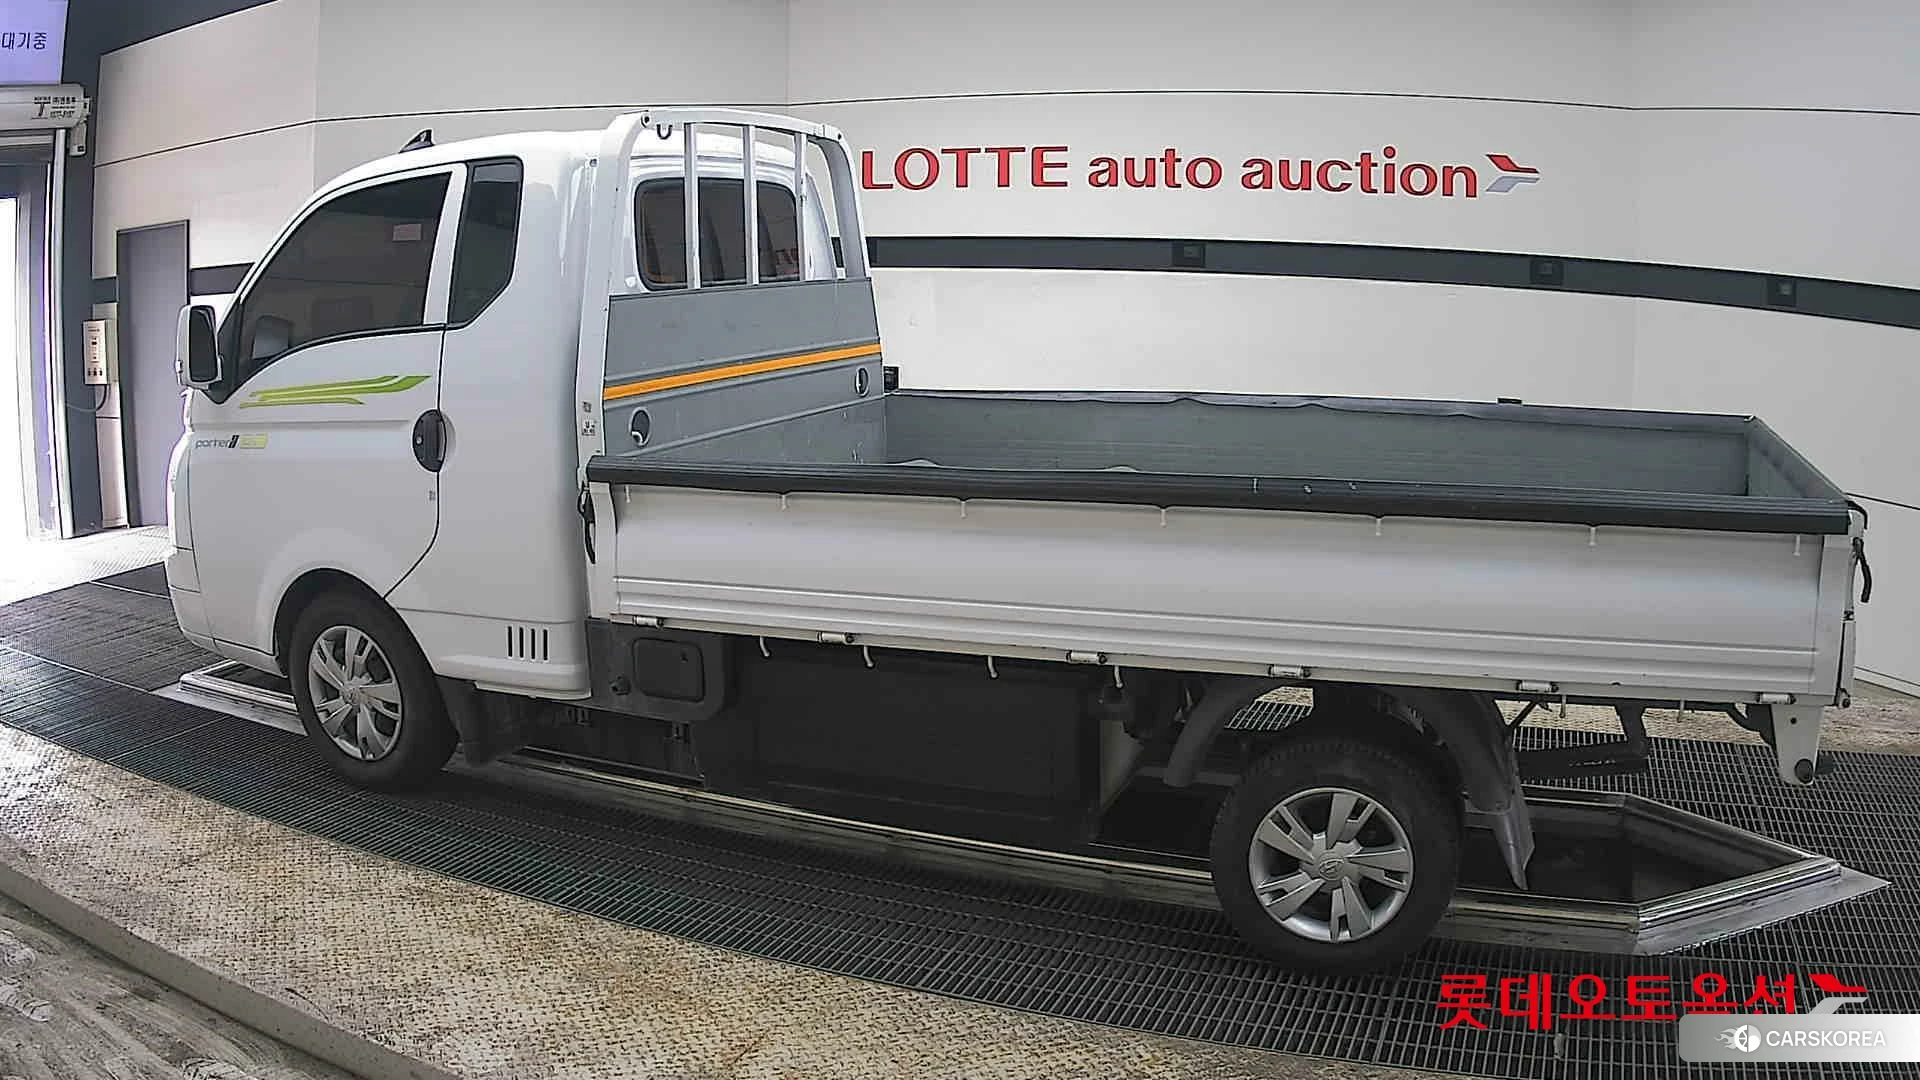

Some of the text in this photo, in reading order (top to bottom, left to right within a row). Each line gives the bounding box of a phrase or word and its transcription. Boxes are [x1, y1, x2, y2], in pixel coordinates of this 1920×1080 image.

[1, 31, 47, 50] 대기중
[861, 146, 1479, 198] LOTTE auto auction
